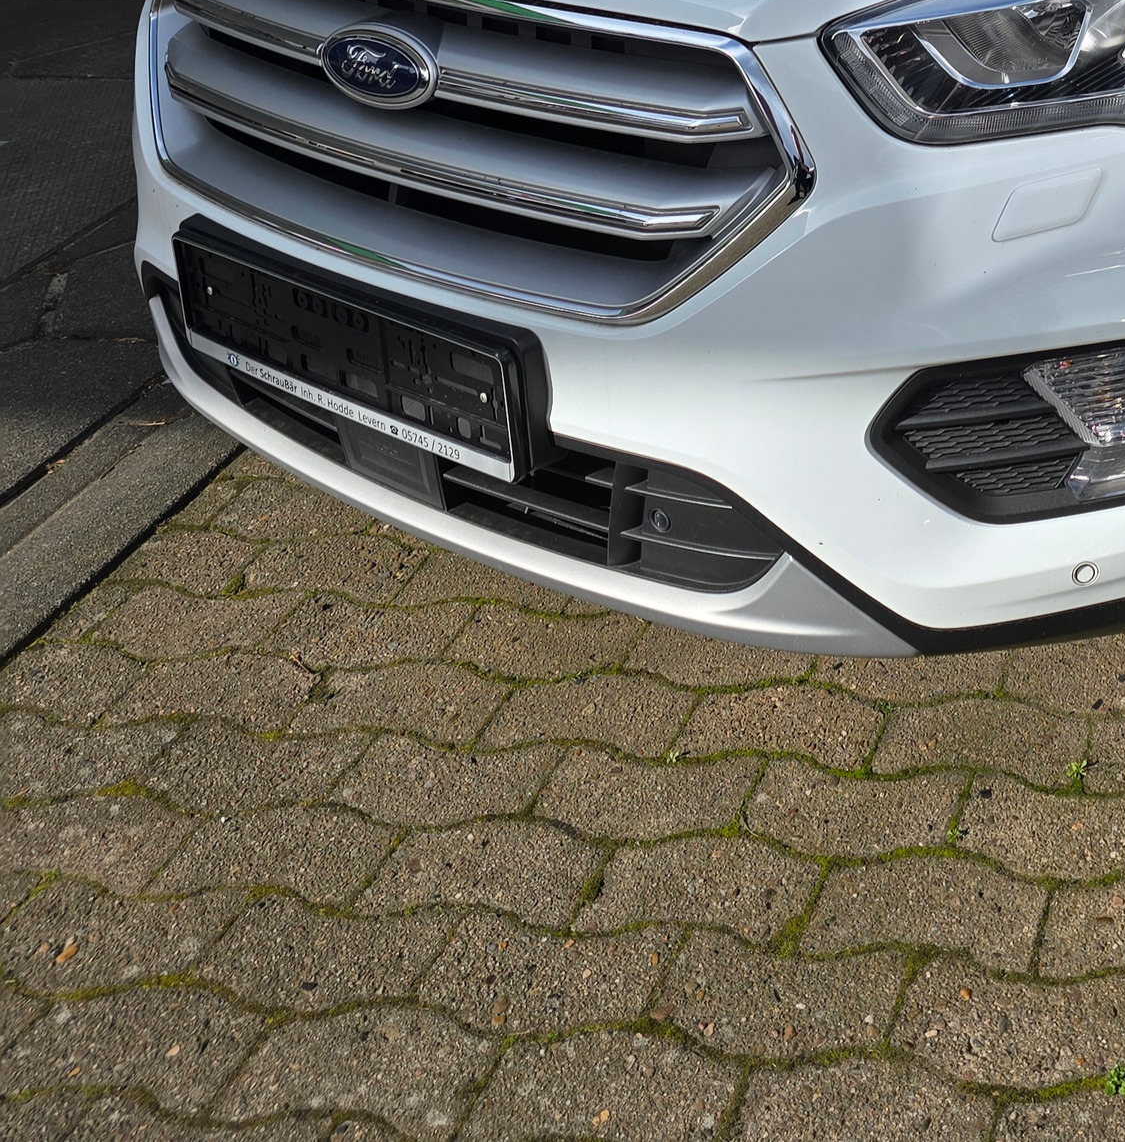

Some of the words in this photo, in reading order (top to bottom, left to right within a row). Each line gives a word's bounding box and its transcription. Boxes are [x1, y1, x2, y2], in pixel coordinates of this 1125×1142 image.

[341, 44, 397, 89] Ford
[245, 361, 258, 376] Der
[259, 368, 297, 393] SchrauBär
[301, 386, 316, 402] Inh.
[317, 394, 326, 406] R.
[327, 399, 354, 418] Hodde
[358, 410, 386, 431] Levern
[401, 429, 429, 448] 05745
[438, 442, 461, 460] 2129
